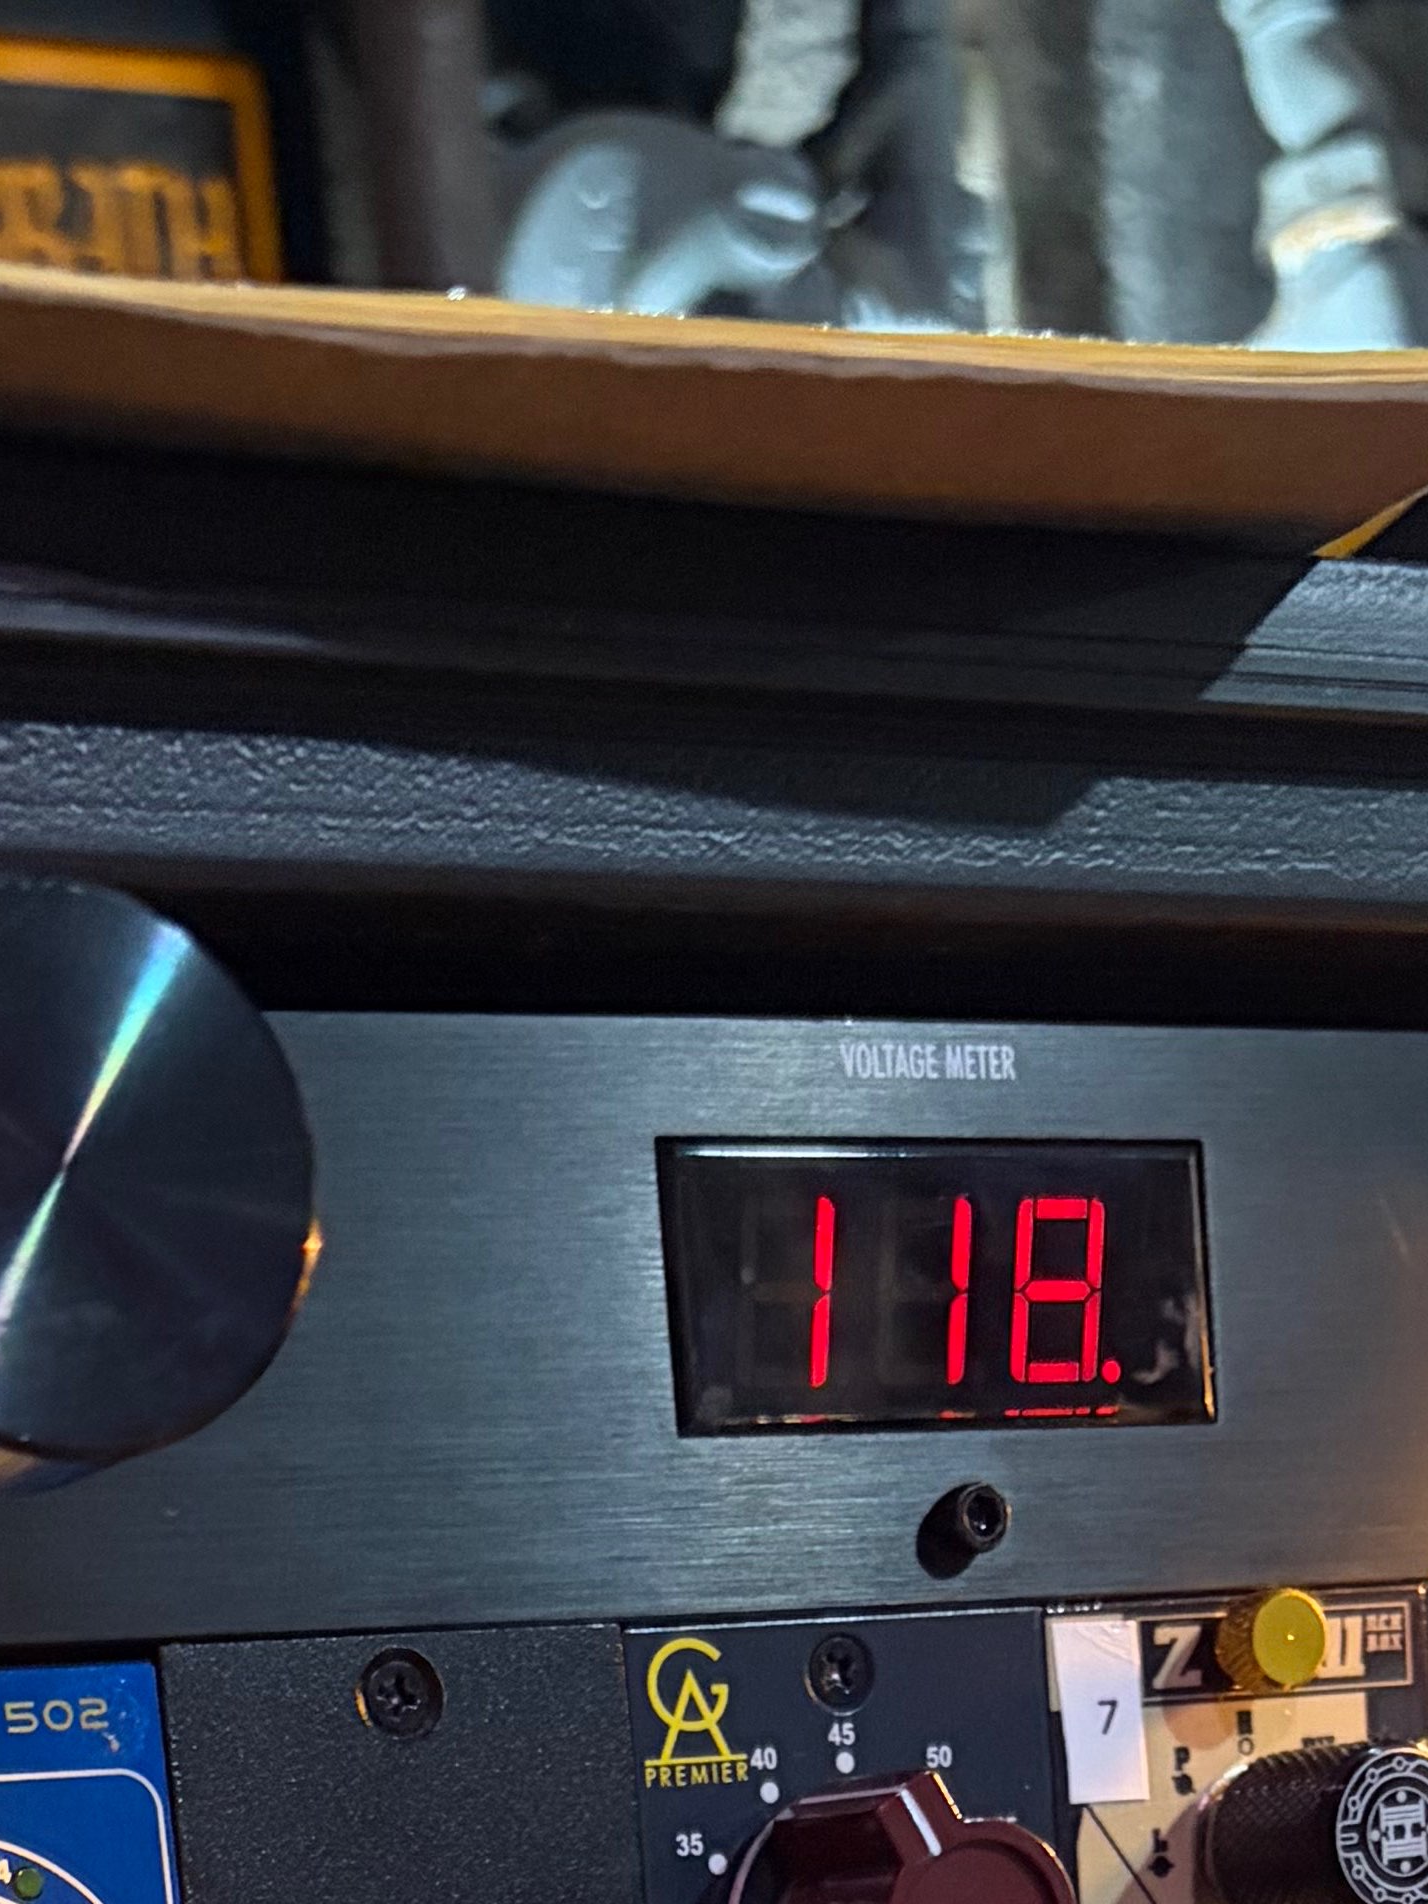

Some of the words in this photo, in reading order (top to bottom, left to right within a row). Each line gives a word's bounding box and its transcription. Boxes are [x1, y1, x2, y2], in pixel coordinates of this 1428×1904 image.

[840, 1043, 939, 1080] VOLTAGE
[945, 1045, 1016, 1080] METER
[4, 1699, 109, 1734] 502
[1097, 1700, 1119, 1735] 7
[828, 1723, 855, 1745] 45
[751, 1748, 778, 1770] 40
[926, 1746, 953, 1767] 50
[644, 1762, 750, 1788] PREMIER
[676, 1834, 704, 1857] 35
